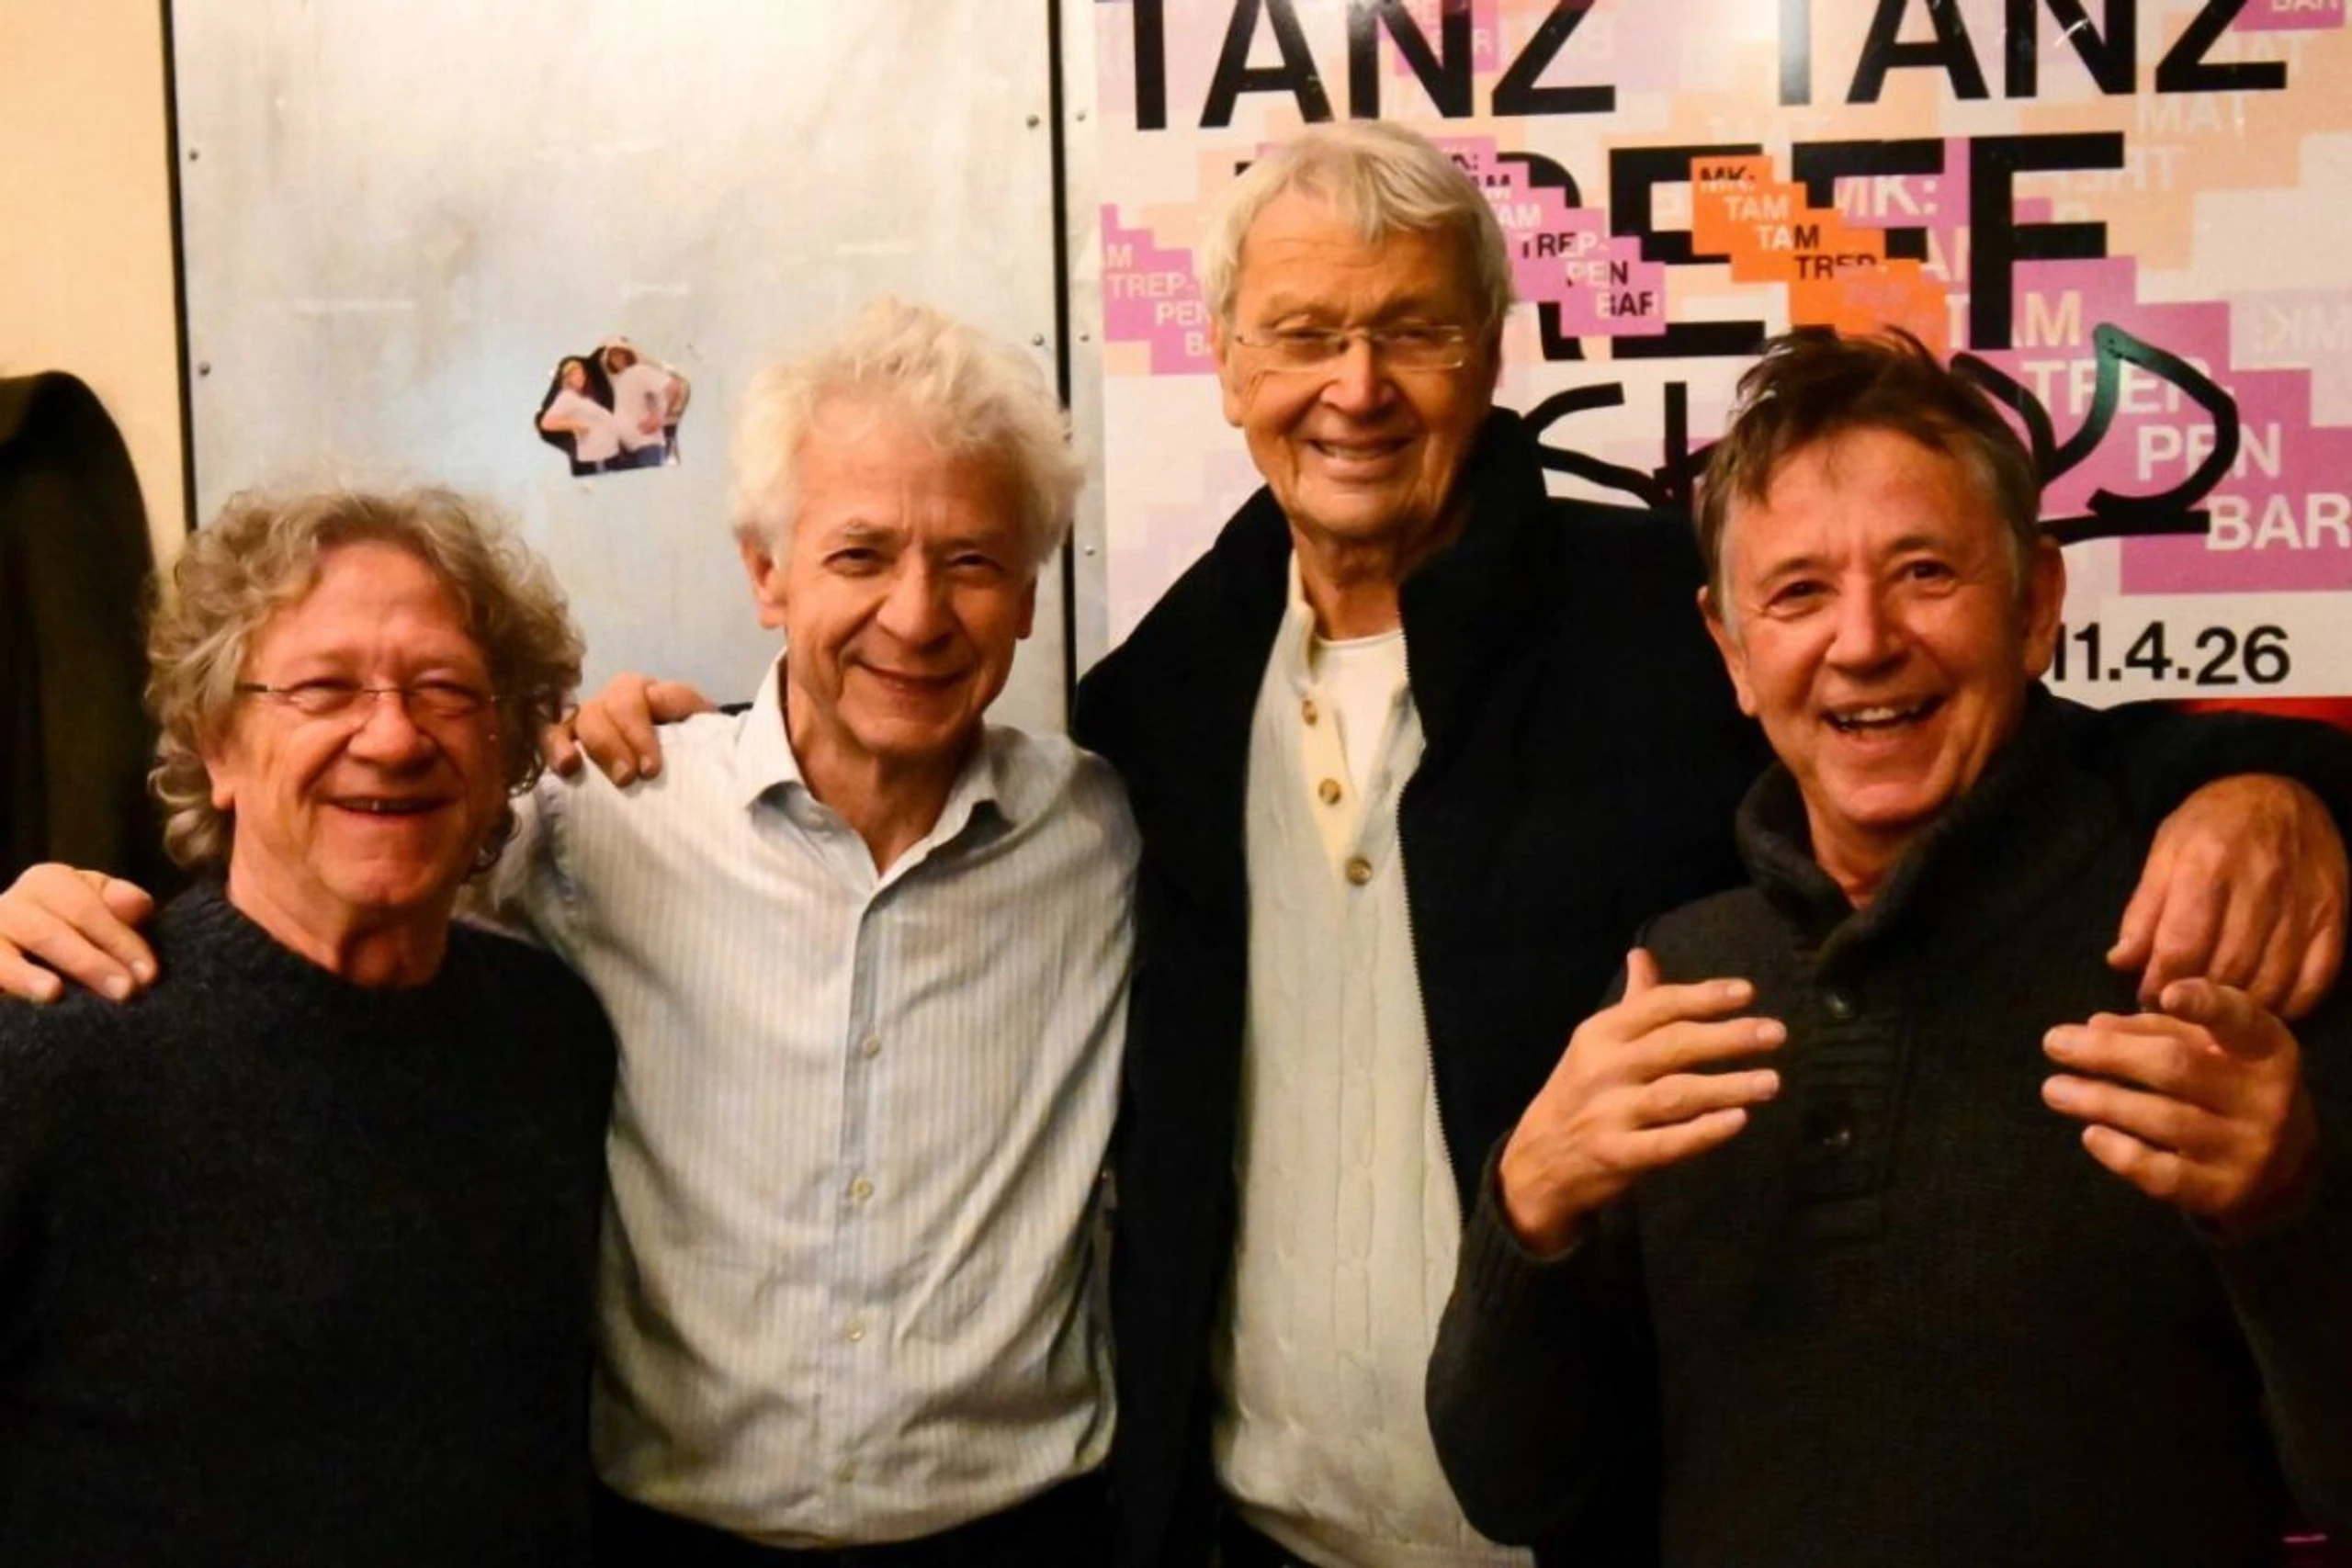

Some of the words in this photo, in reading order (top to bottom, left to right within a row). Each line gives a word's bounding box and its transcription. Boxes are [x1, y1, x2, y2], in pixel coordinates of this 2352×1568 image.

[1095, 0, 1615, 130] TANZ
[1779, 0, 2287, 106] TANZ
[1724, 194, 1790, 221] TAM
[1234, 132, 2125, 362] EFF
[1758, 224, 1820, 251] TAM
[1105, 272, 1197, 299] TREP-
[1566, 260, 1629, 287] PEN
[1944, 290, 2083, 349] TM
[2207, 492, 2352, 550] BAR
